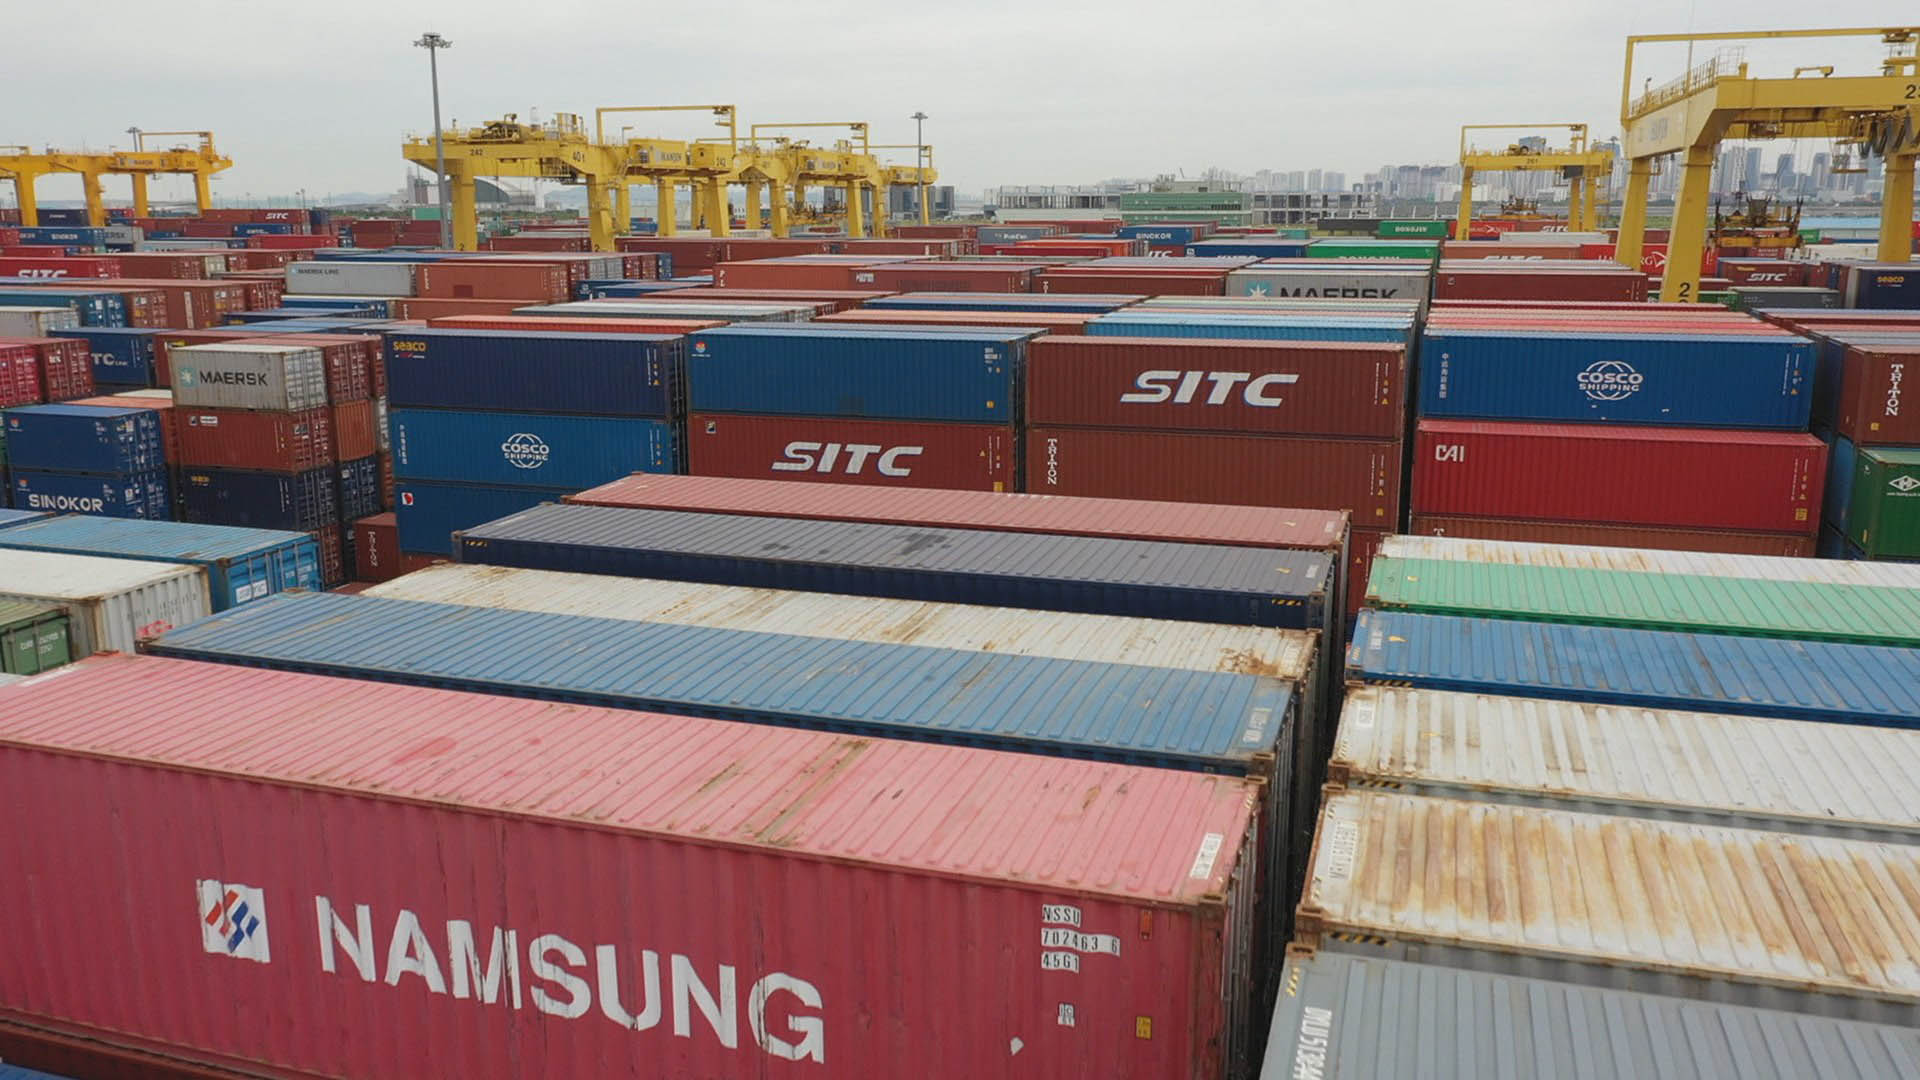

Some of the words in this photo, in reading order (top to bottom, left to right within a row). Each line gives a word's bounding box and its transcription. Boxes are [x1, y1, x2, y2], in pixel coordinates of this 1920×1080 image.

[1747, 273, 1787, 282] SITC
[393, 341, 426, 351] seaco
[200, 371, 268, 387] MAERSK
[1576, 372, 1644, 384] COSCO
[1120, 370, 1299, 408] SITC
[1578, 383, 1640, 392] SHIPPING
[1885, 364, 1904, 416] TRITON
[502, 442, 549, 454] COSCO
[504, 452, 548, 461] SHIPPING
[1435, 444, 1464, 462] CAI
[771, 441, 923, 477] SITC
[1047, 438, 1057, 485] TRITON
[29, 494, 103, 512] SINOKOR
[1043, 906, 1080, 925] NSSU
[1043, 930, 1098, 951] 702463
[1111, 938, 1118, 954] 6
[1043, 953, 1078, 970] 45G1
[315, 895, 824, 1064] NAMSUNG
